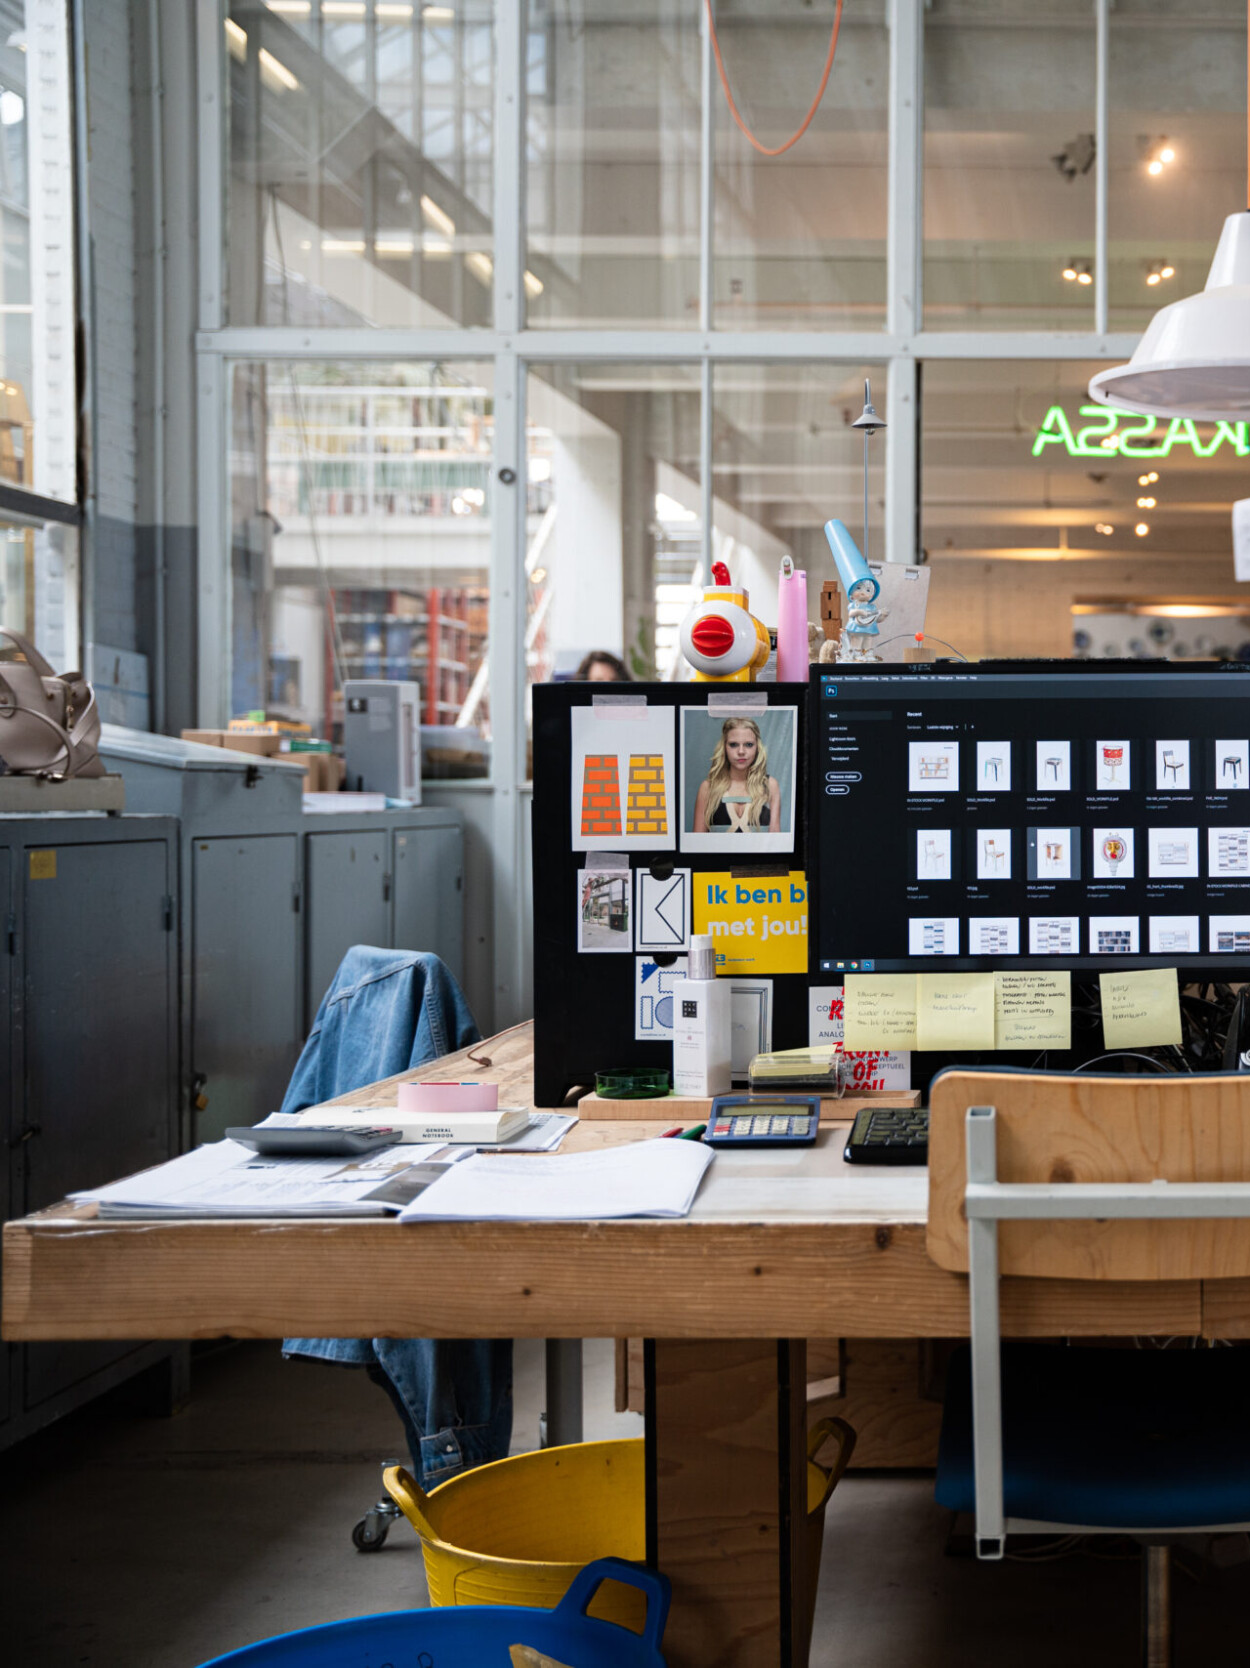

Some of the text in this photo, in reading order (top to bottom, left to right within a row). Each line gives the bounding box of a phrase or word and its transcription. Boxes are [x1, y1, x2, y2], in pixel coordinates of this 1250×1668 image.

[708, 882, 808, 904] Ik ben b
[707, 915, 807, 941] met jou!
